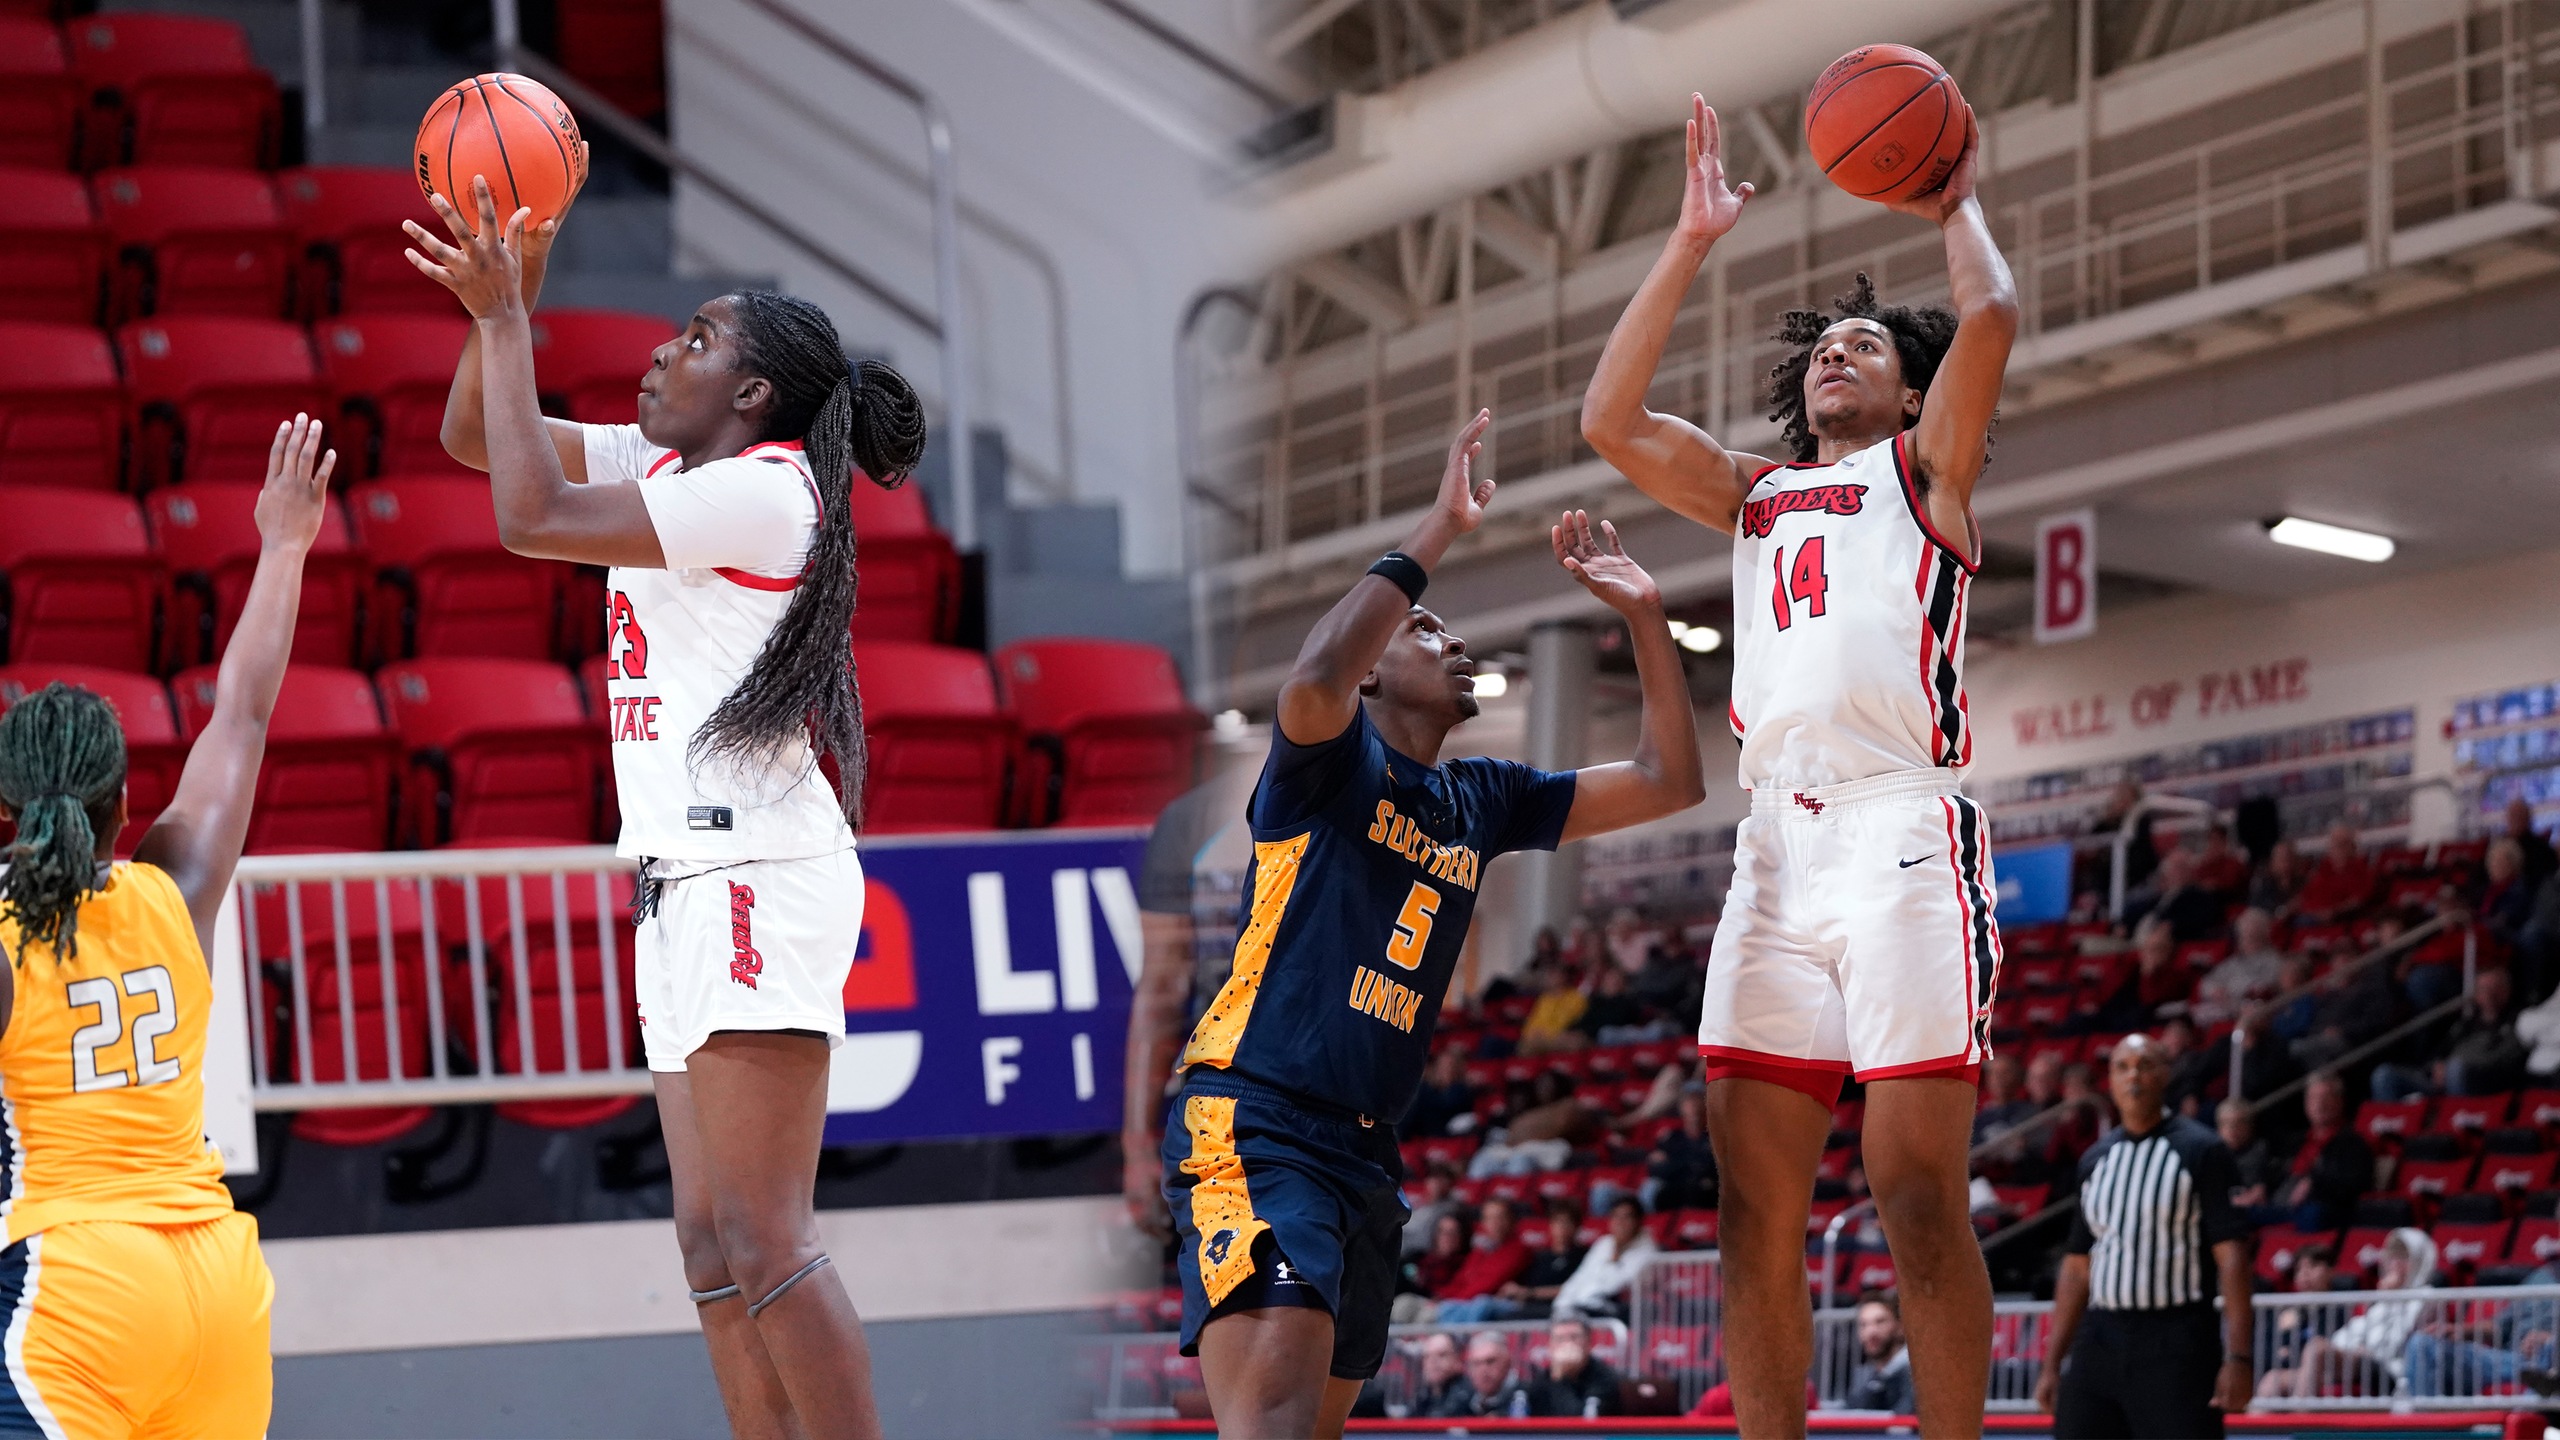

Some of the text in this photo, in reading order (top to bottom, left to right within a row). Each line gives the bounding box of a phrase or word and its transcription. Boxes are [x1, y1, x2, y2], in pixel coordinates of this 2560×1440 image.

[1772, 535, 1828, 632] 14
[2045, 524, 2086, 629] B
[610, 696, 662, 742] TATE
[2011, 657, 2311, 746] WALL OF FAME
[717, 813, 725, 823] L
[1367, 799, 1480, 892] SOUTHERN
[728, 879, 763, 991] RAIDERS
[1386, 880, 1441, 971] 5
[66, 964, 181, 1093] 22
[1349, 965, 1423, 1034] UNION
